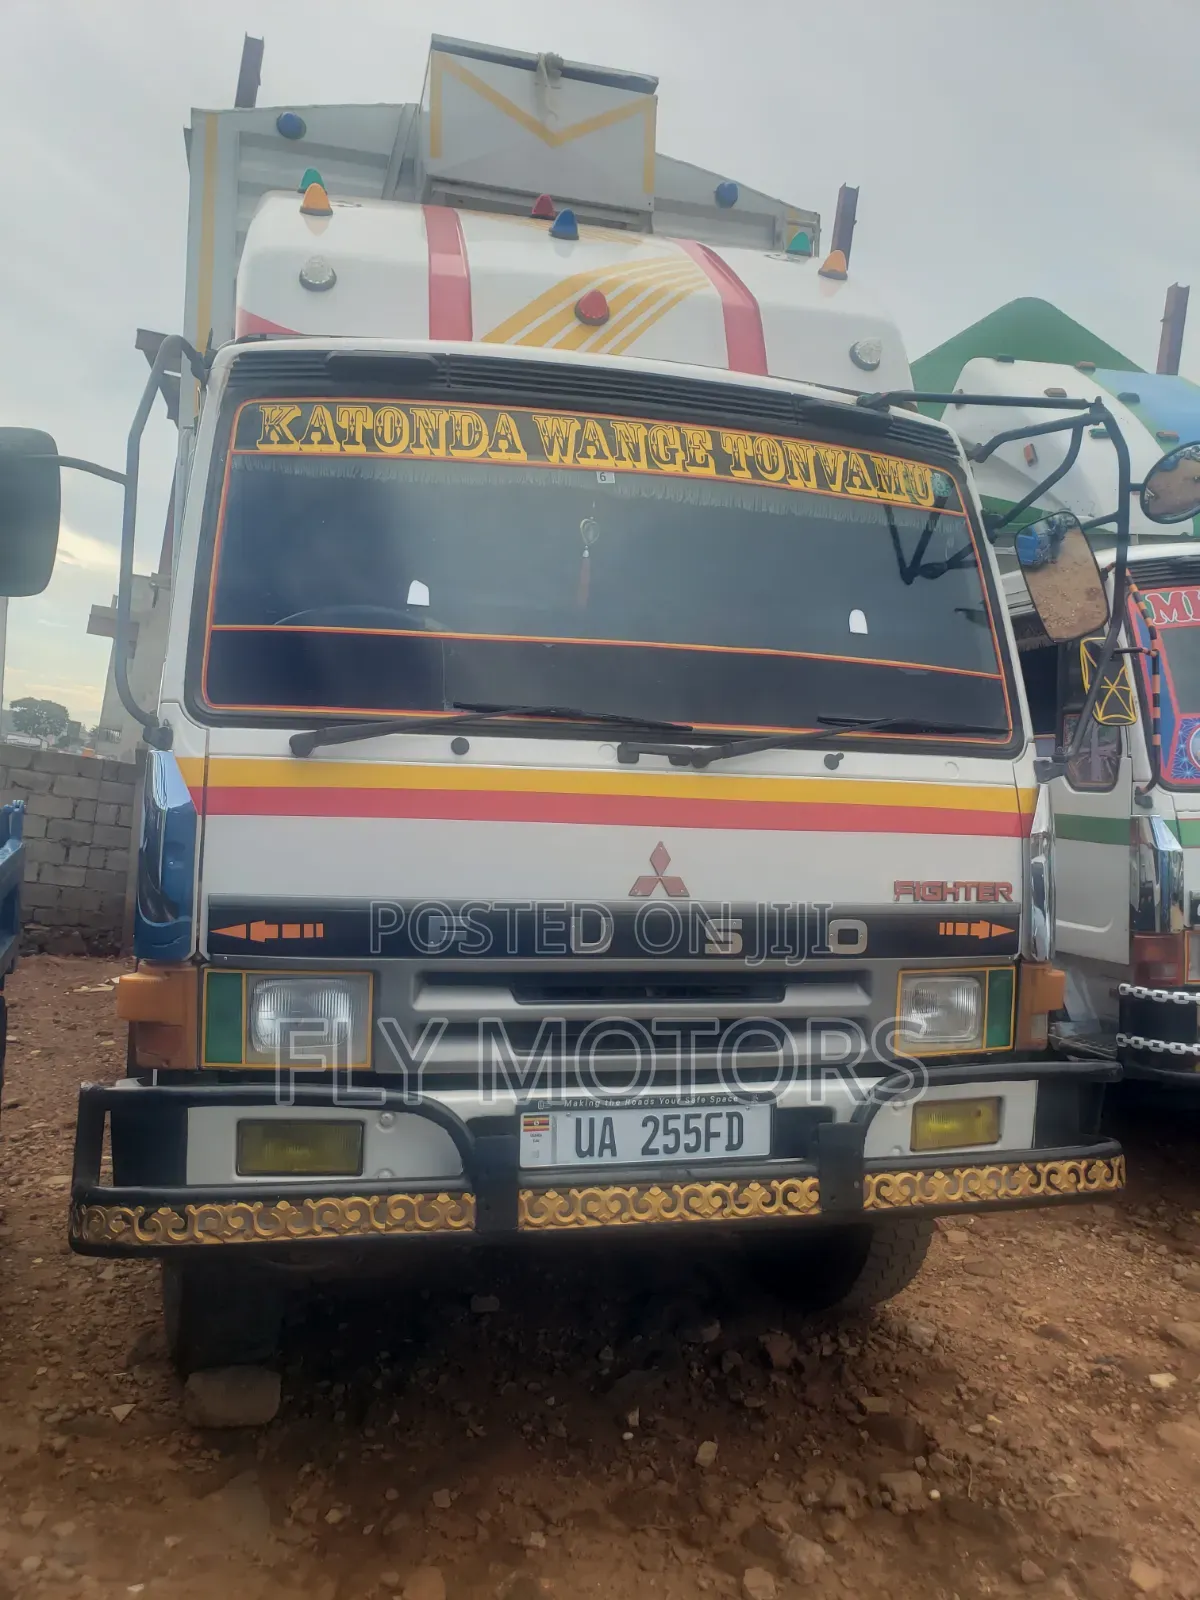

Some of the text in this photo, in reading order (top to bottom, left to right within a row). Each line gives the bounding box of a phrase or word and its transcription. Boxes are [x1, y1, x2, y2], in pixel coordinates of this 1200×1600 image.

[256, 404, 528, 462] KATONDA
[531, 415, 717, 476] WANGE
[720, 431, 935, 507] TONVAMU
[893, 880, 1014, 902] FIGHTER
[563, 1094, 739, 1108] Making the Roads Your Safe Space
[574, 1111, 744, 1158] UA 255FD
